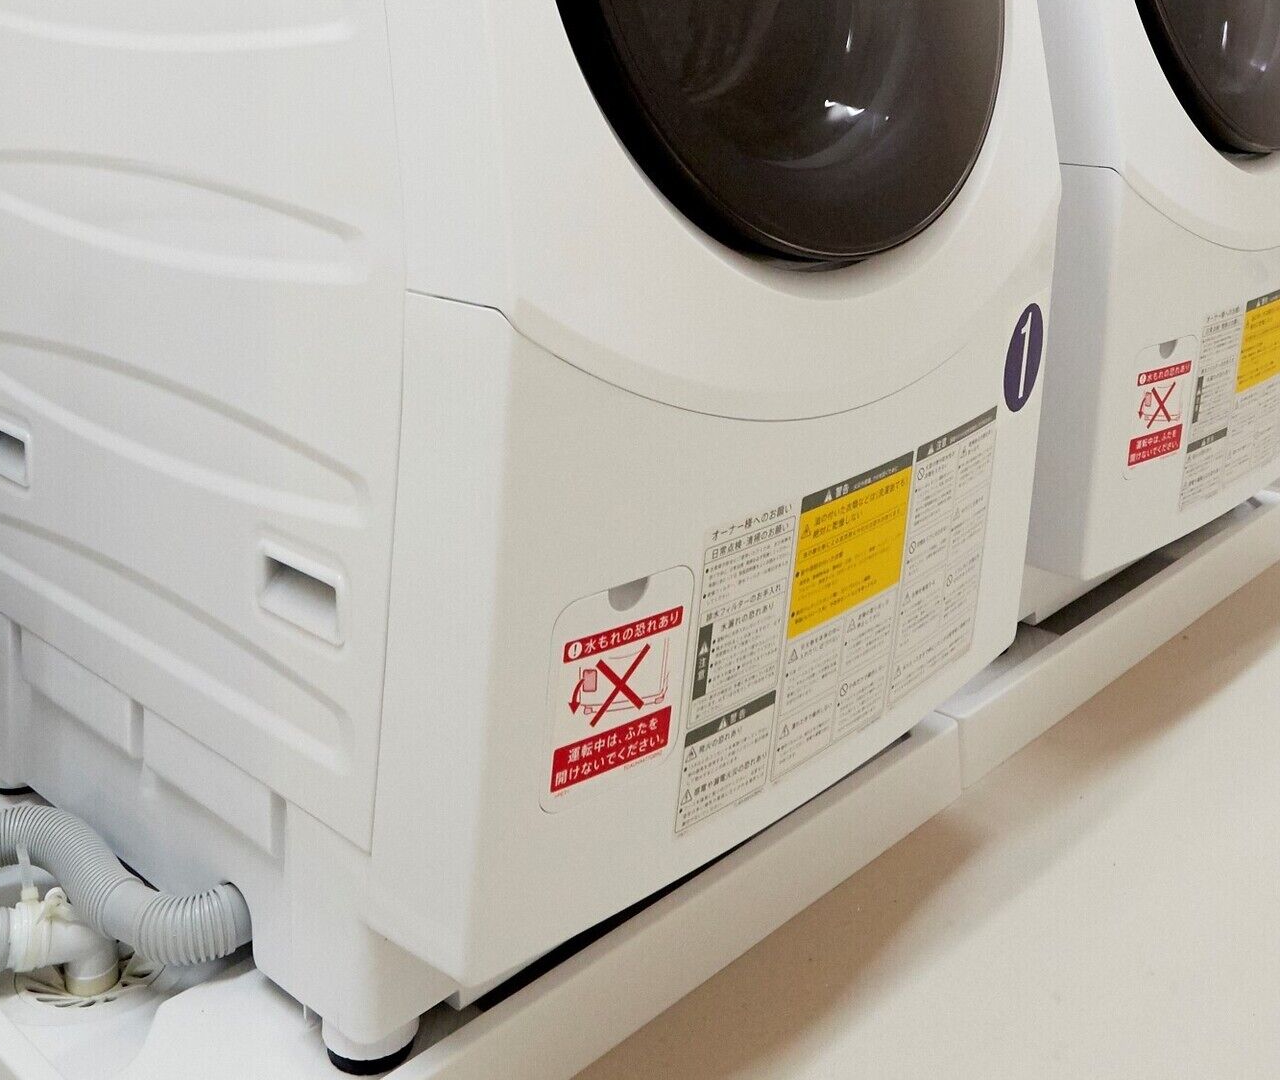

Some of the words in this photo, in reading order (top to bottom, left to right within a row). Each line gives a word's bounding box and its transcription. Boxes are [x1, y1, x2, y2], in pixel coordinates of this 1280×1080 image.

[1020, 311, 1032, 399] 1
[711, 503, 792, 541] オーナー様へのお願い
[585, 611, 681, 655] 水もれの恐れあり
[555, 734, 665, 787] 開けないでください。
[568, 717, 658, 765] 運転中は、ふたを
